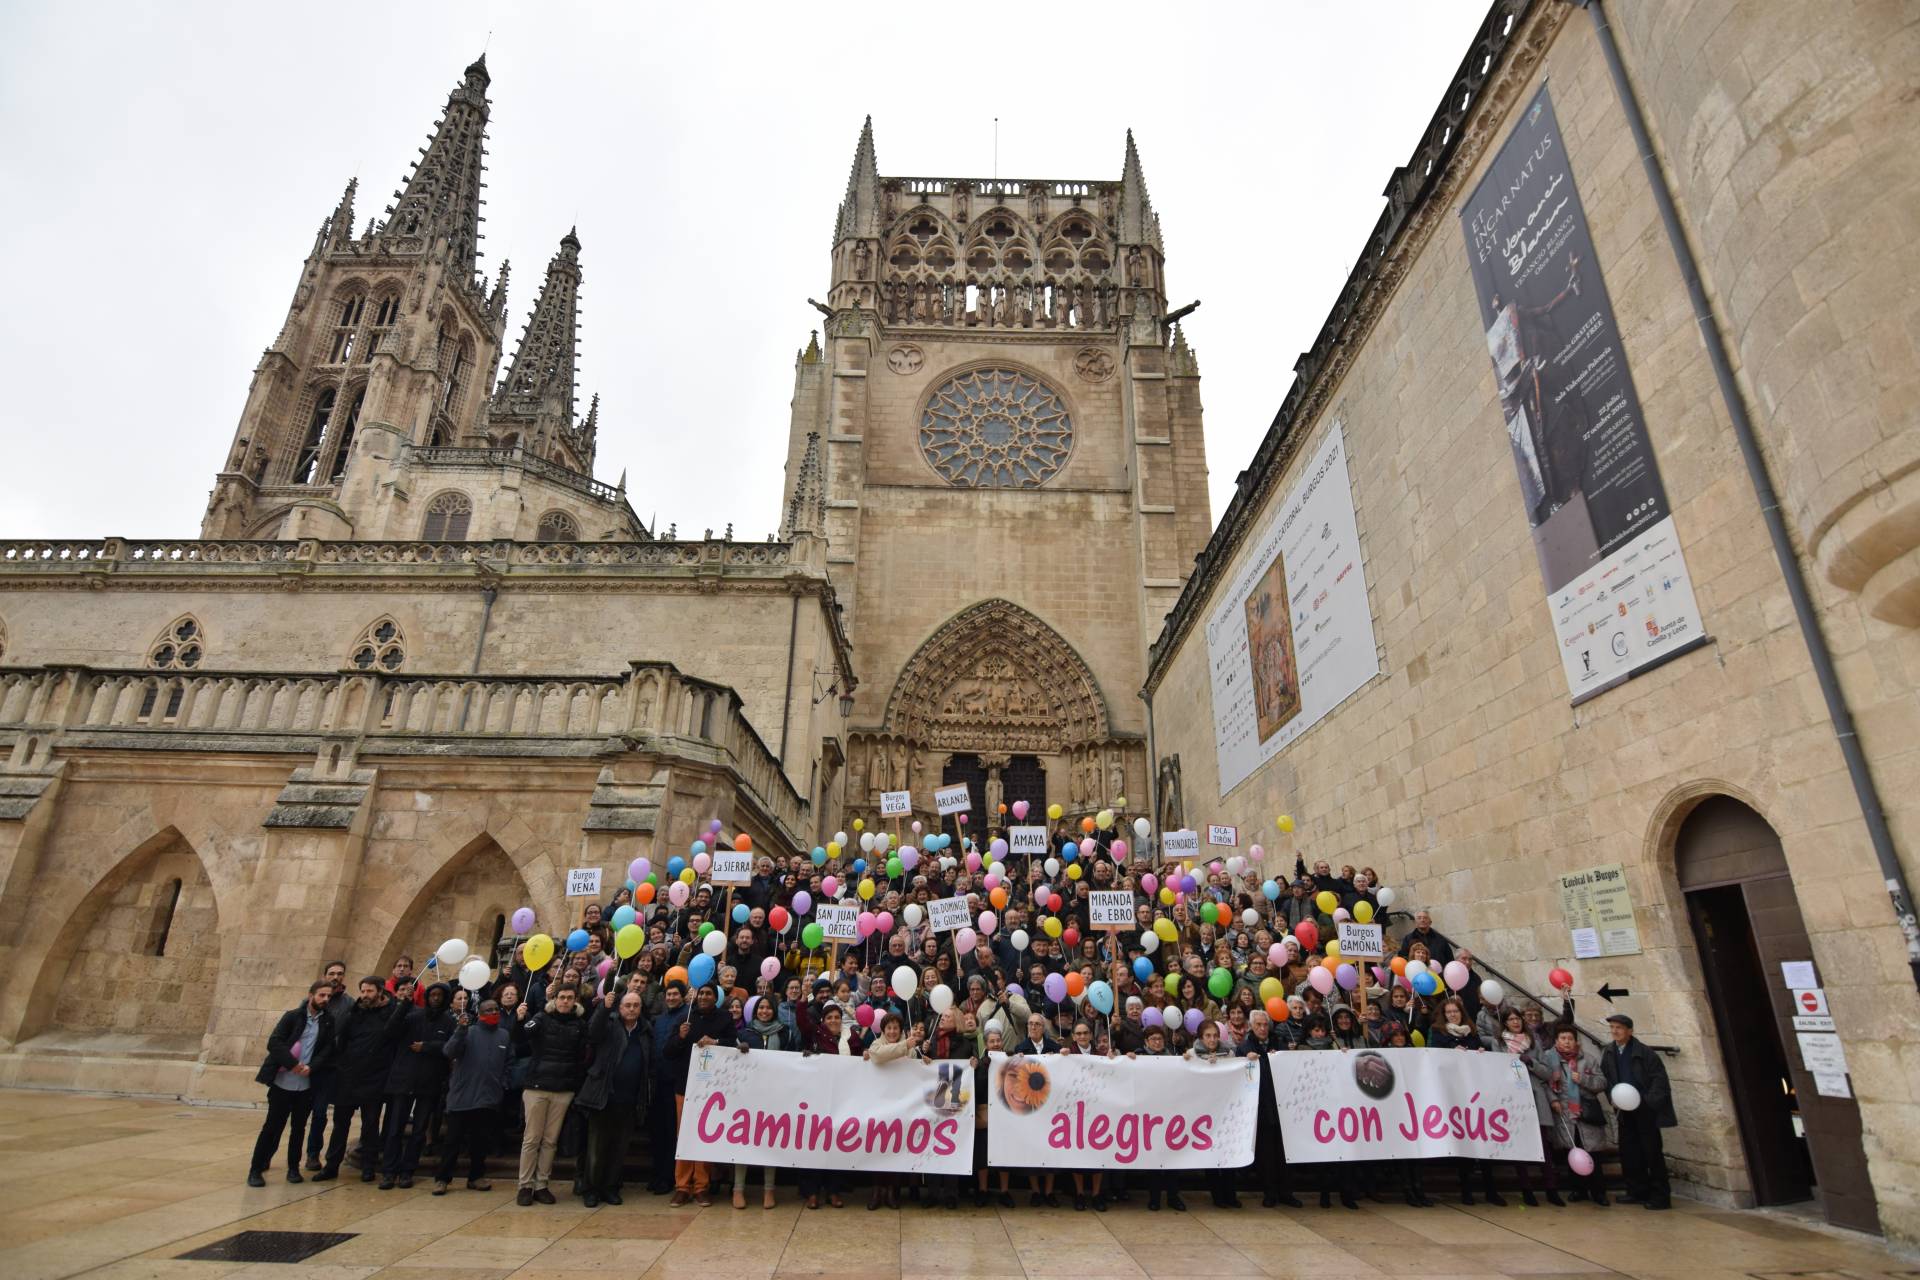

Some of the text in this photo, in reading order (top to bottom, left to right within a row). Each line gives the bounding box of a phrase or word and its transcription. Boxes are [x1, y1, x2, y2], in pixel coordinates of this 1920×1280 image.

[1475, 133, 1552, 249] INCARNATUS
[1472, 209, 1484, 234] ET
[1480, 230, 1497, 264] EST
[1515, 215, 1573, 288] VENANCIO BLANCO
[1571, 312, 1600, 345] GRATUITA
[1586, 319, 1604, 339] FREE
[1587, 347, 1611, 371] Palencia
[1591, 413, 1611, 434] octubre
[1611, 400, 1627, 416] 2019
[1302, 467, 1325, 504] BURGOS
[1325, 444, 1339, 472] 2021
[1660, 621, 1677, 632] Junta
[886, 803, 906, 812] VEGA
[938, 794, 968, 808] ARLANZA
[1014, 834, 1044, 846] AMAYA
[1164, 837, 1198, 850] MERINDADES
[724, 862, 750, 872] SIERRA
[574, 870, 596, 882] Burgos
[1594, 870, 1619, 882] Burgos
[572, 882, 595, 893] VENA
[940, 900, 966, 913] DOMINGO
[1092, 894, 1132, 906] MIRANDA
[817, 909, 857, 924] SAN JUAN
[1092, 908, 1132, 920] de EBRO
[933, 917, 942, 928] de
[828, 924, 856, 936] ORTEGA
[1346, 925, 1374, 940] Burgos
[1340, 940, 1382, 952] GAMONAL
[698, 1091, 958, 1156] Caminemos
[1314, 1092, 1510, 1144] con Jesús
[1048, 1100, 1213, 1164] alegres
